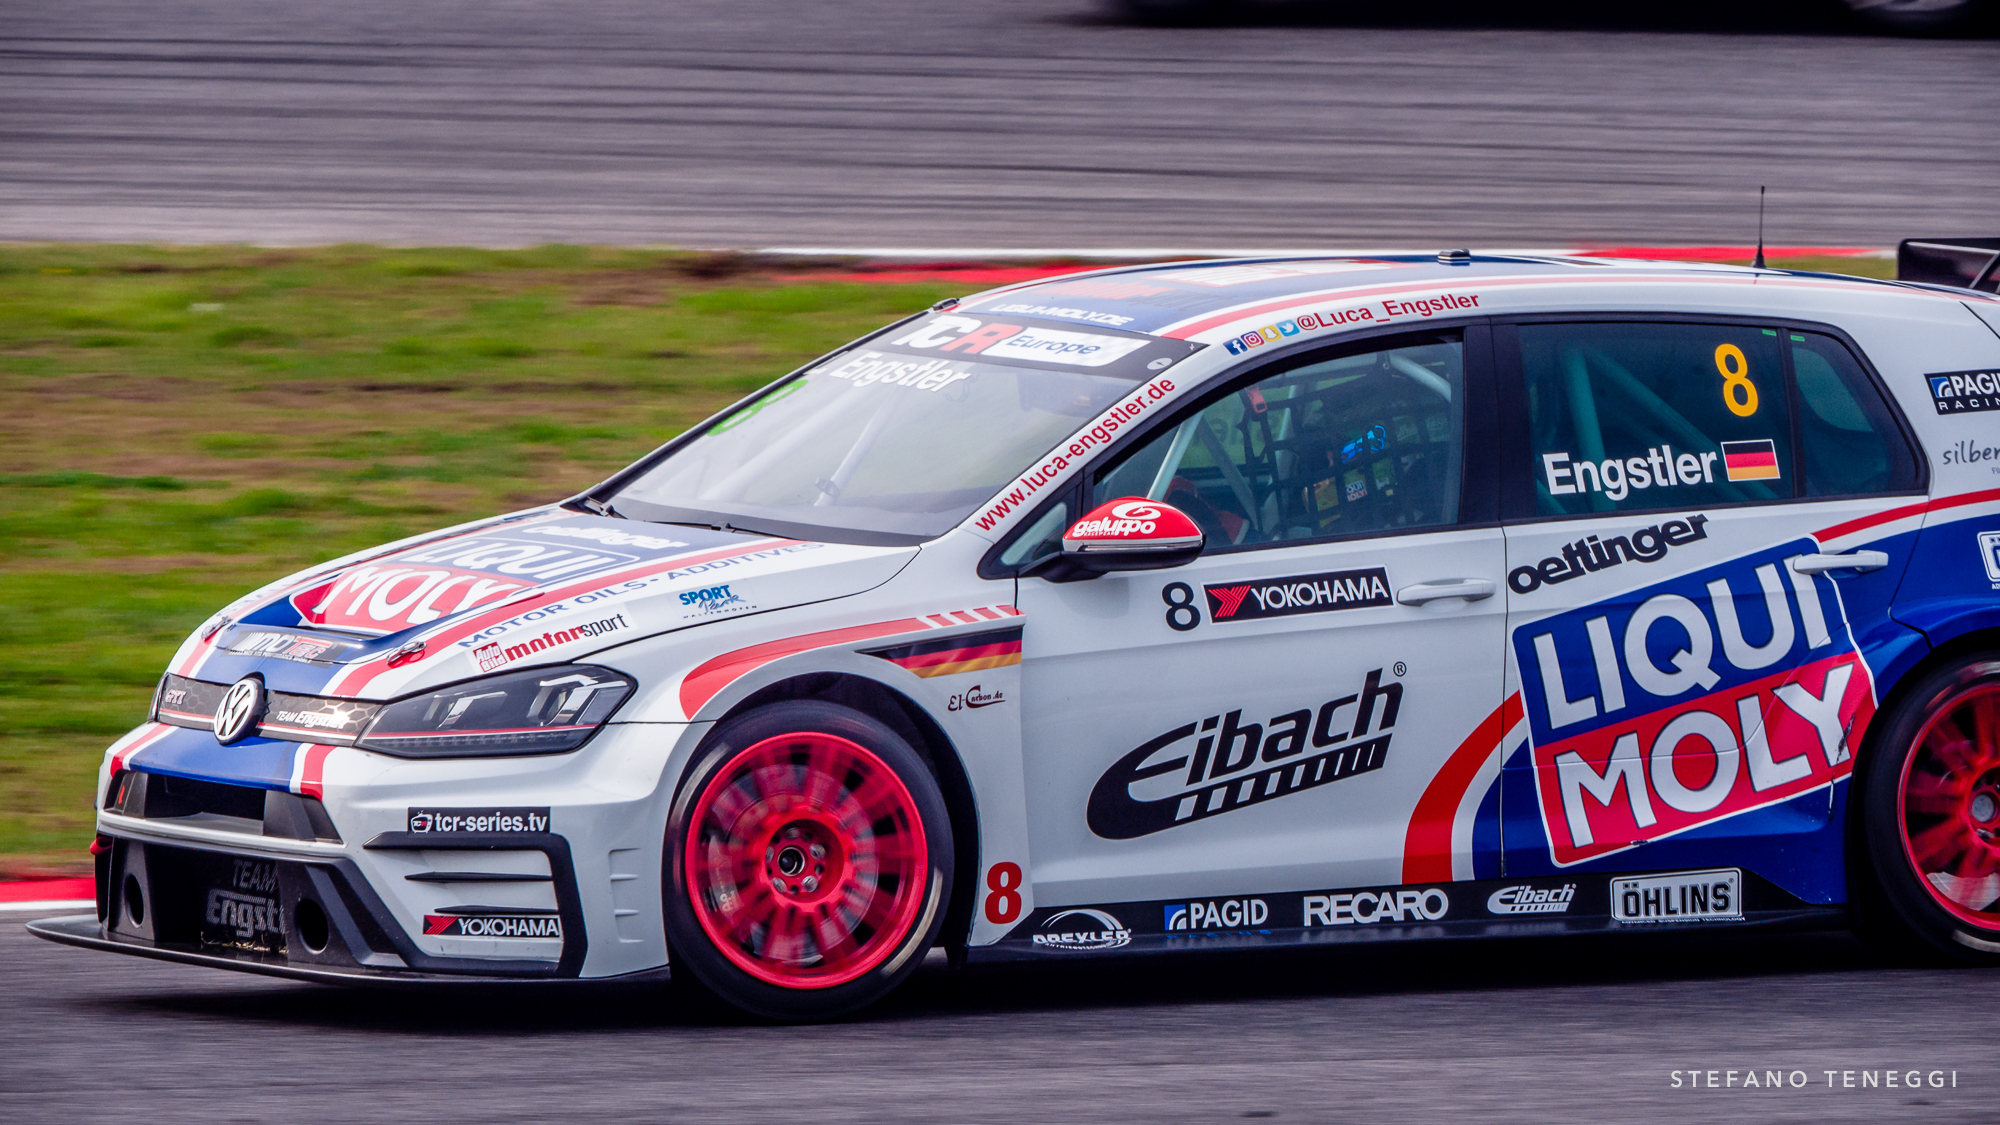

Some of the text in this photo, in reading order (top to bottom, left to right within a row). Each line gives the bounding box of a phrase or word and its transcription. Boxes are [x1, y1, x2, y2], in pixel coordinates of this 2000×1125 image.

[1297, 293, 1480, 331] @Luca_Engstler
[891, 315, 1023, 354] TCR
[1005, 335, 1102, 355] Europe
[828, 351, 972, 392] Engstler
[1715, 343, 1759, 417] 8
[974, 376, 1176, 532] www.luca-engstler.de
[1543, 445, 1718, 501] Engstler
[1072, 516, 1156, 537] galuppo
[400, 540, 616, 580] LIQUI
[1508, 513, 1709, 594] oettinger
[311, 565, 525, 625] MOLY
[457, 541, 825, 648] MOTOR OILS ADDITIVES
[679, 584, 731, 605] SPORT
[1162, 582, 1201, 631] 8
[1251, 576, 1389, 610] YOKOHAMA
[475, 643, 501, 662] Auto
[505, 613, 629, 661] motorsport
[1532, 553, 1831, 731] LIQUI
[480, 655, 506, 671] Bild
[165, 689, 186, 704] GTI
[276, 711, 350, 729] TEAM Engstler
[1086, 668, 1405, 840] Eibach
[1555, 662, 1855, 849] MOLY
[434, 812, 548, 832] tcr-series.tv
[232, 859, 279, 894] TEAM
[984, 861, 1023, 924] 8
[1190, 899, 1269, 929] PAGID
[1304, 889, 1448, 928] RECARO
[1487, 884, 1575, 915] Eibach
[1622, 881, 1731, 918] ÖHLINS
[458, 918, 560, 936] YOKOHAMA
